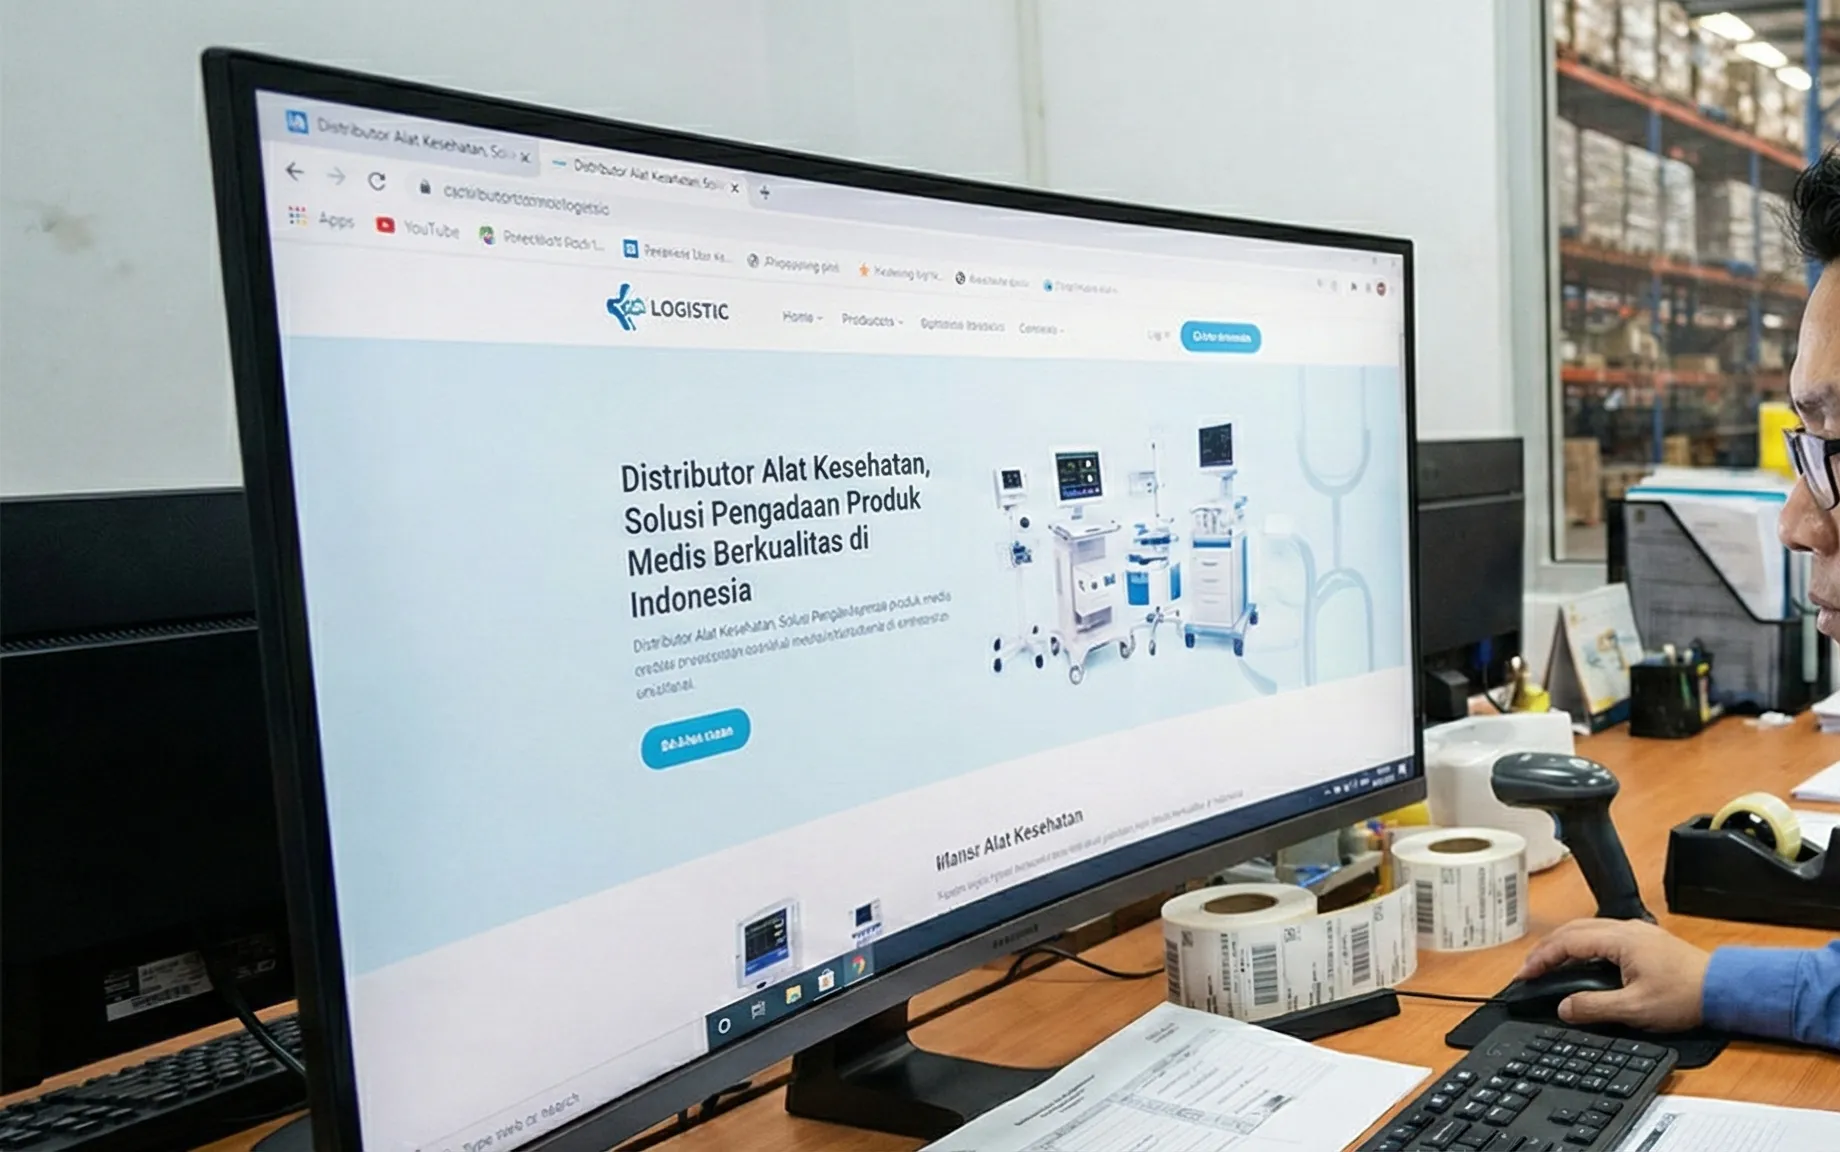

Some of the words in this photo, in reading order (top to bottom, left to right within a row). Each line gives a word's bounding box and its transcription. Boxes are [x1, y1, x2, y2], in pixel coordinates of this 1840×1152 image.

[319, 210, 355, 230] Apps
[404, 220, 461, 239] YouTube
[651, 300, 730, 320] LOGISTIC
[622, 458, 755, 493] Distributor
[762, 455, 807, 483] Alat
[814, 452, 931, 480] Kesehatan,
[625, 501, 704, 534] Solusi
[712, 494, 840, 530] Pengadaan
[847, 485, 921, 514] Produk
[628, 542, 706, 577] Medis
[714, 530, 843, 567] Berkualitas
[850, 525, 869, 551] di
[631, 577, 752, 618] Indonesia
[984, 833, 1011, 855] Alat
[1014, 810, 1084, 844] Kesehatan
